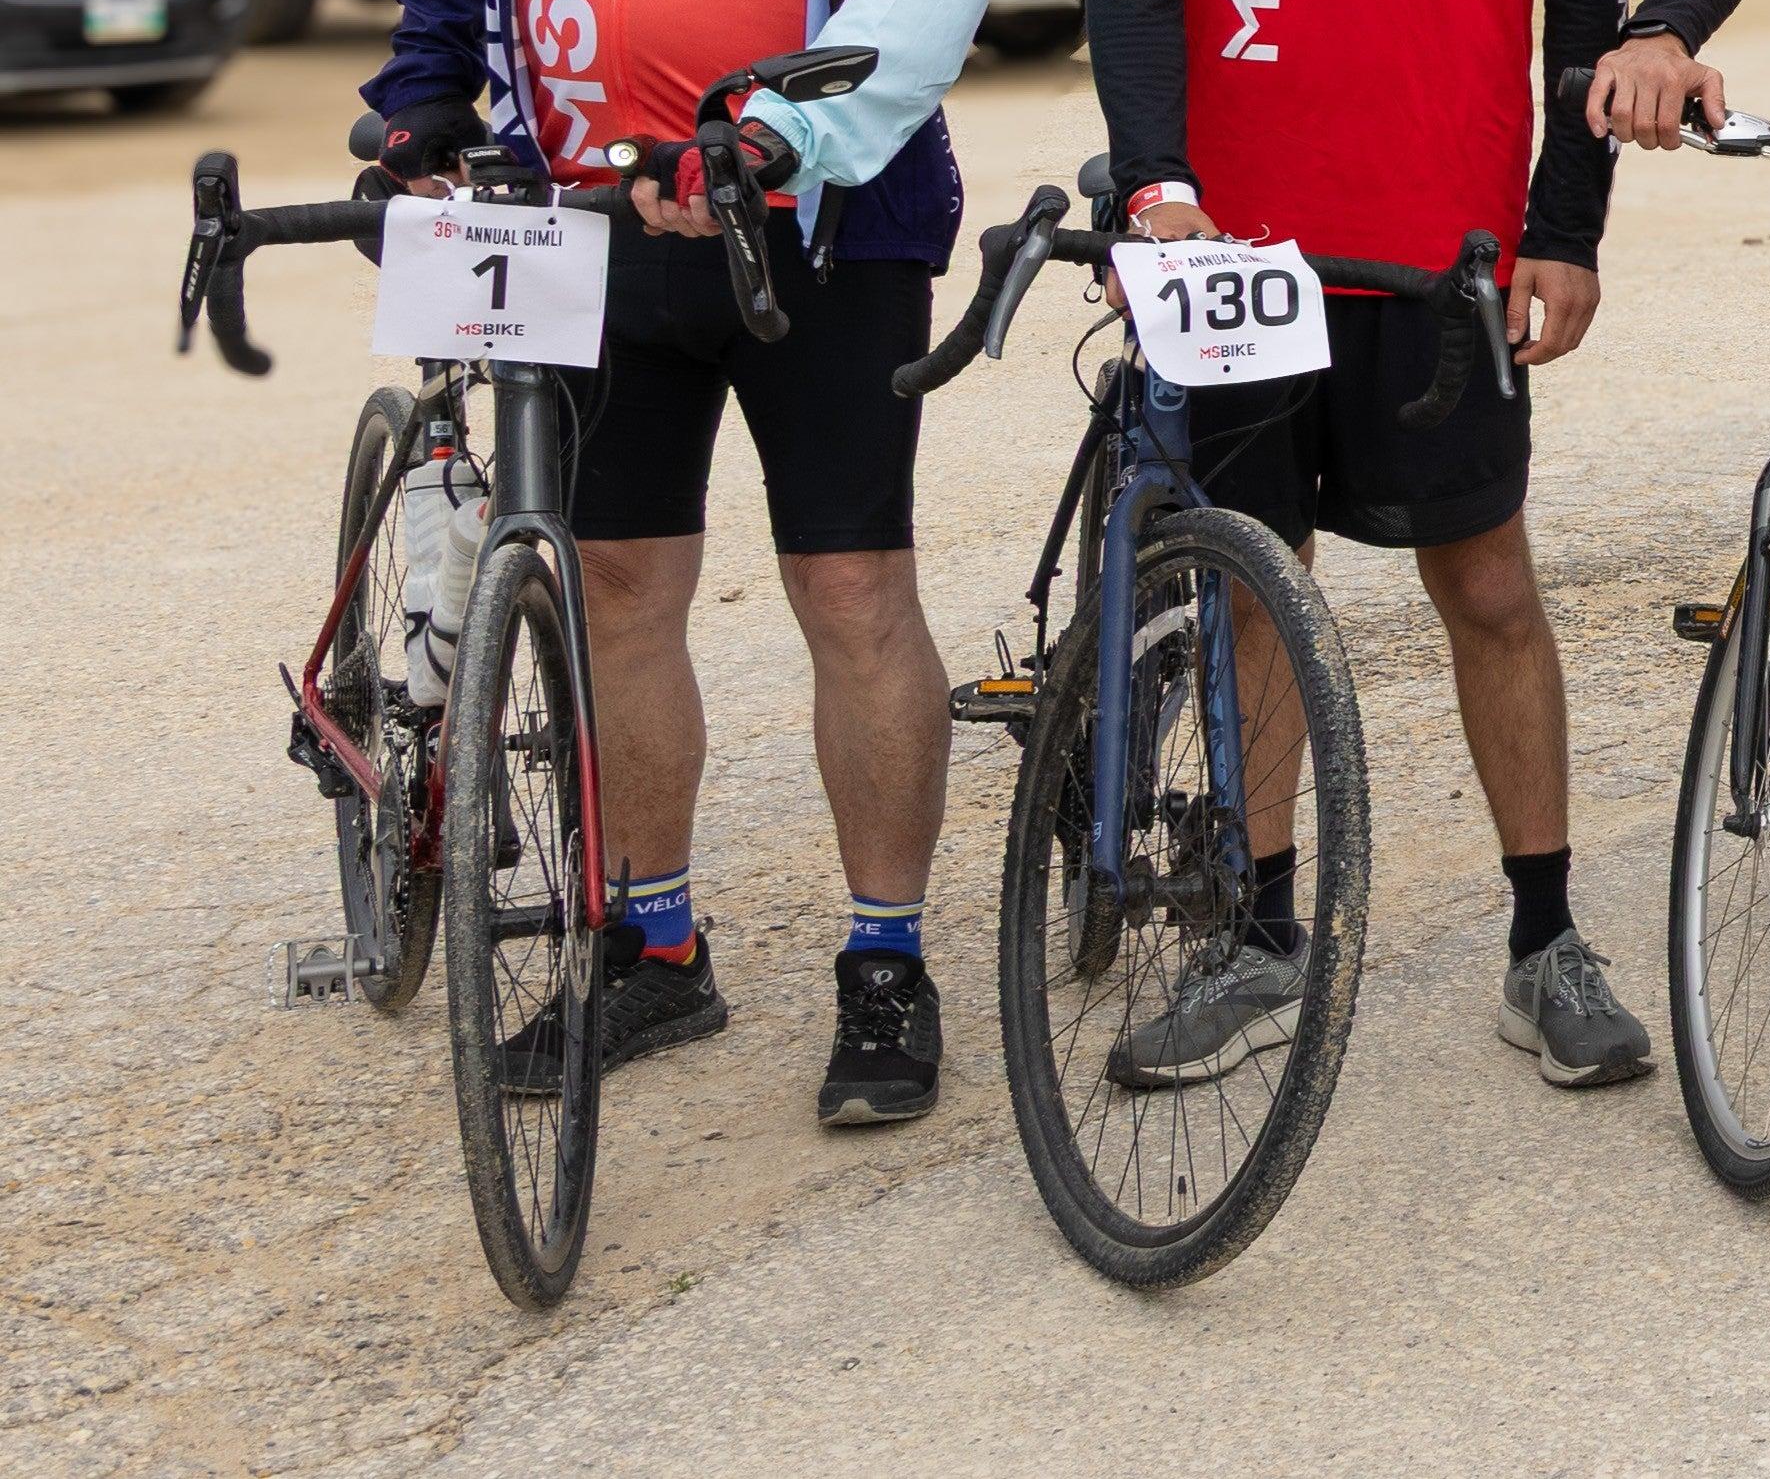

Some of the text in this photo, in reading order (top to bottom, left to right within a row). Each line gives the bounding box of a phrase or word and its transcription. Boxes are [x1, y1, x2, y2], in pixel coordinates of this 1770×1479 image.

[434, 221, 563, 247] 36TH ANNUAL GIMLI
[1158, 257, 1185, 273] 36TH
[1188, 252, 1235, 269] ANNUAL
[471, 254, 509, 310] 1
[1157, 269, 1299, 333] 130
[456, 323, 526, 336] MSBIKE
[1199, 343, 1256, 360] MSBIKE
[635, 892, 688, 915] VÉLO
